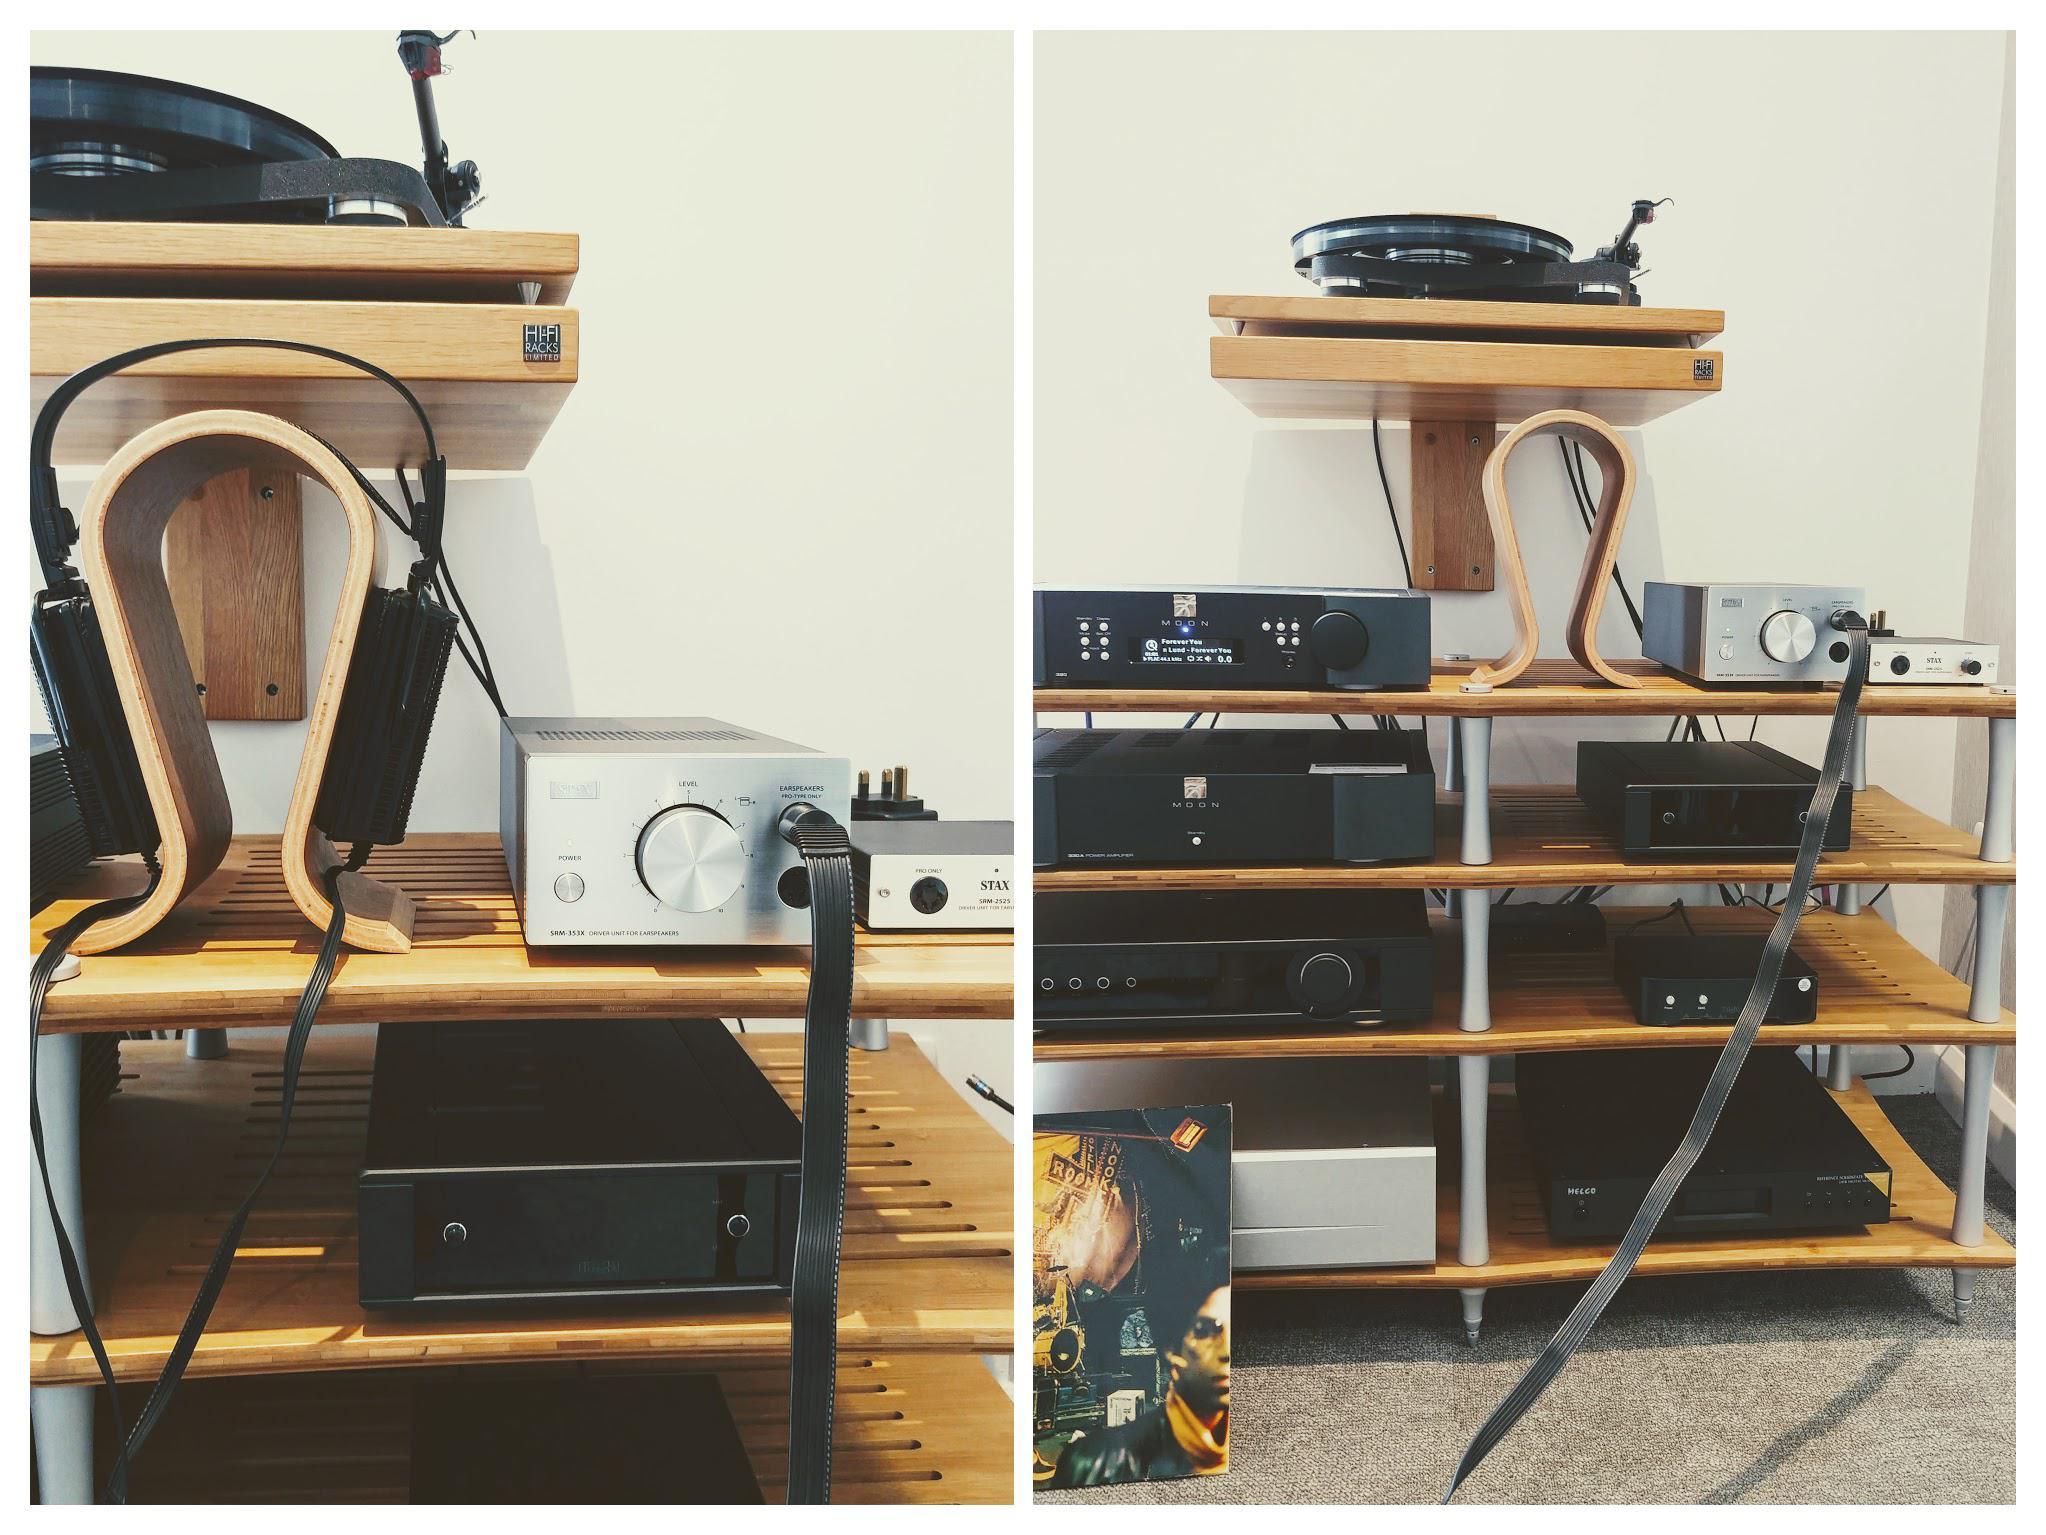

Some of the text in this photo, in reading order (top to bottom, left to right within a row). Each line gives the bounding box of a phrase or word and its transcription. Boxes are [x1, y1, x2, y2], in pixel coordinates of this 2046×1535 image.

[525, 325, 559, 342] HI-FI
[525, 343, 559, 353] RACKS
[980, 880, 1010, 891] STAX
